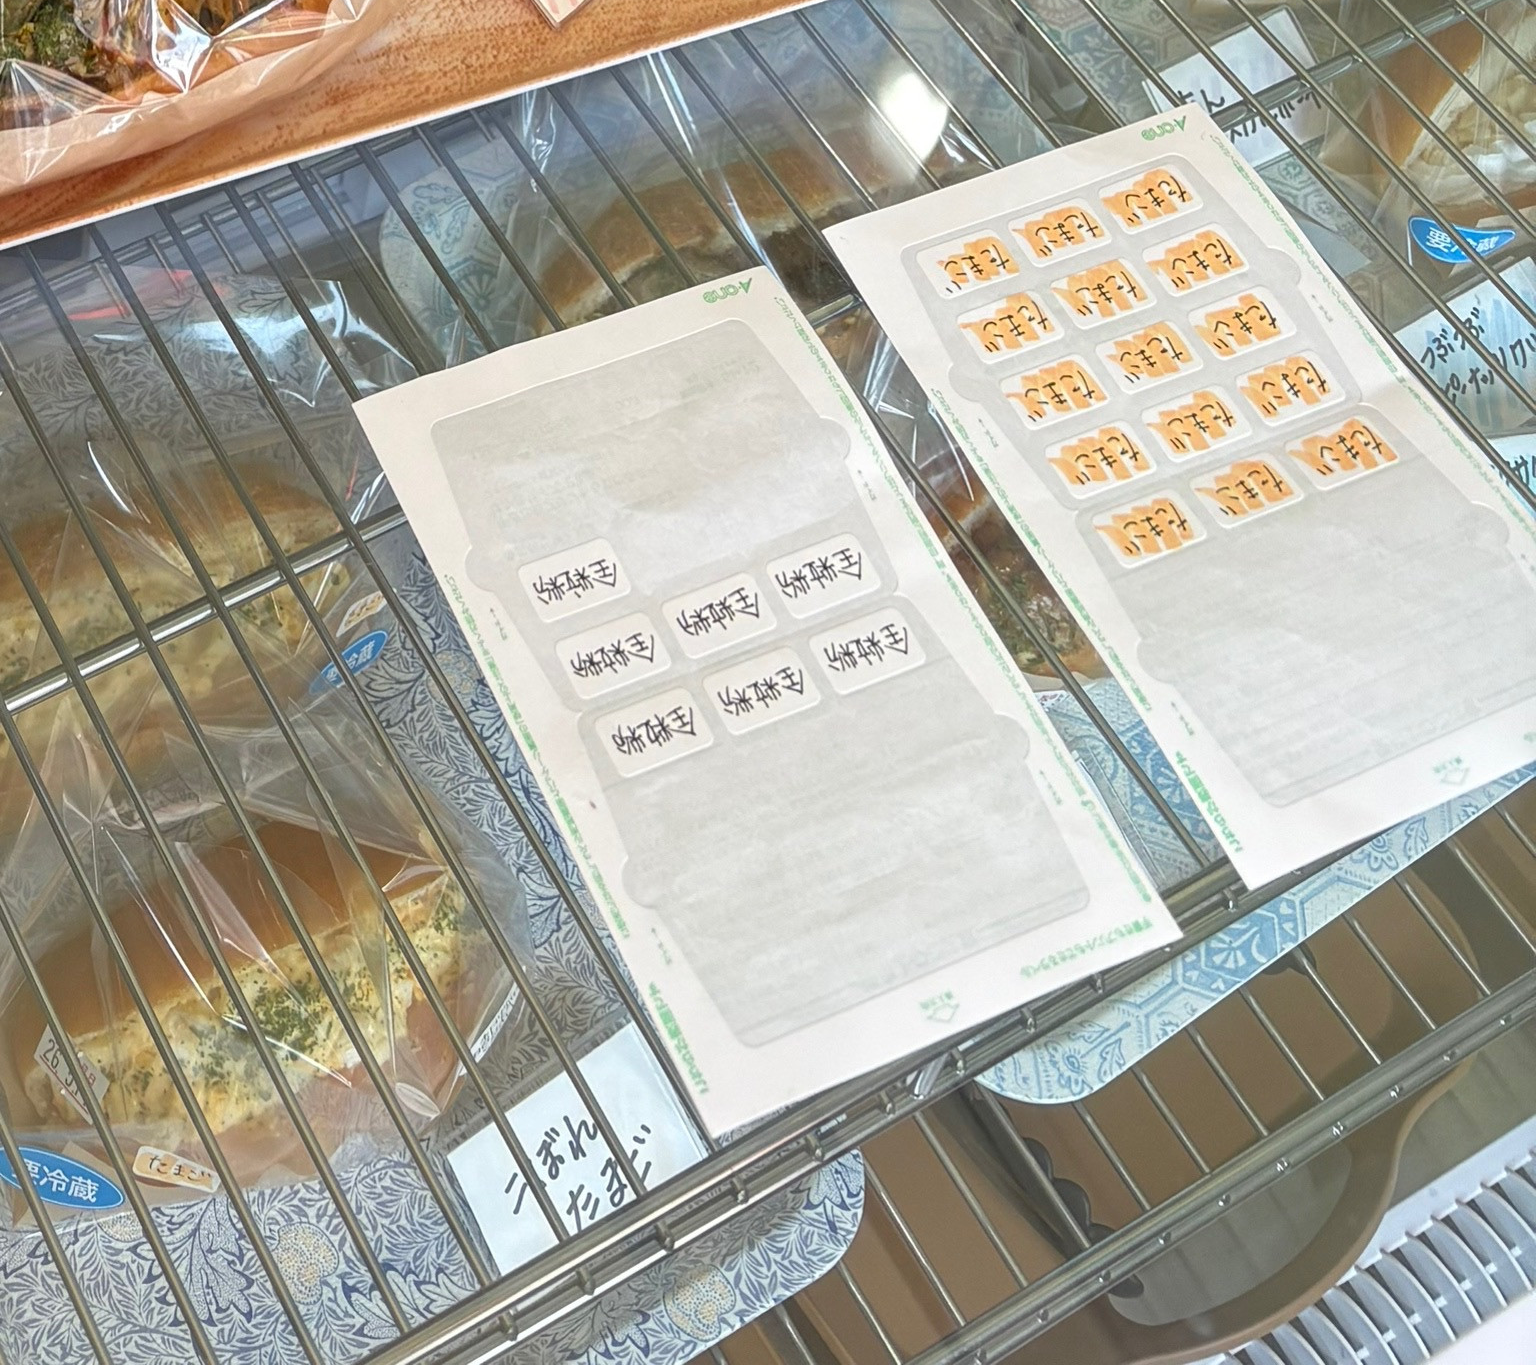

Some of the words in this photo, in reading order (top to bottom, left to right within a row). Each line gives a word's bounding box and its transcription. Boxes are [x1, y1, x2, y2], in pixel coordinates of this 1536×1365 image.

[1123, 173, 1188, 223] たまご
[1033, 209, 1099, 256] たまご
[943, 246, 1011, 293] たまご
[1169, 240, 1233, 288] たまご
[1073, 271, 1138, 316] たまご
[981, 298, 1049, 353] たまご
[1211, 301, 1278, 349] たまご
[1118, 334, 1184, 384] たまご
[1023, 372, 1096, 422] たまご
[1260, 358, 1328, 414] たまご
[1168, 401, 1234, 449] たまご
[1315, 422, 1383, 475] たまご
[1074, 433, 1140, 485] たまご
[1218, 467, 1283, 515] たまご
[1121, 505, 1188, 553] たまご
[532, 559, 617, 605] 全粒粉
[775, 548, 862, 598] 全粒粉
[676, 587, 760, 636] 全粒粉
[570, 632, 654, 678] 全粒粉
[823, 623, 908, 671] 全粒粉
[717, 666, 804, 716] 全粒粉
[611, 706, 697, 755] 全粒粉
[148, 1154, 212, 1183] たまご
[504, 1114, 599, 1216] こぼれ
[566, 1123, 653, 1233] たまご
